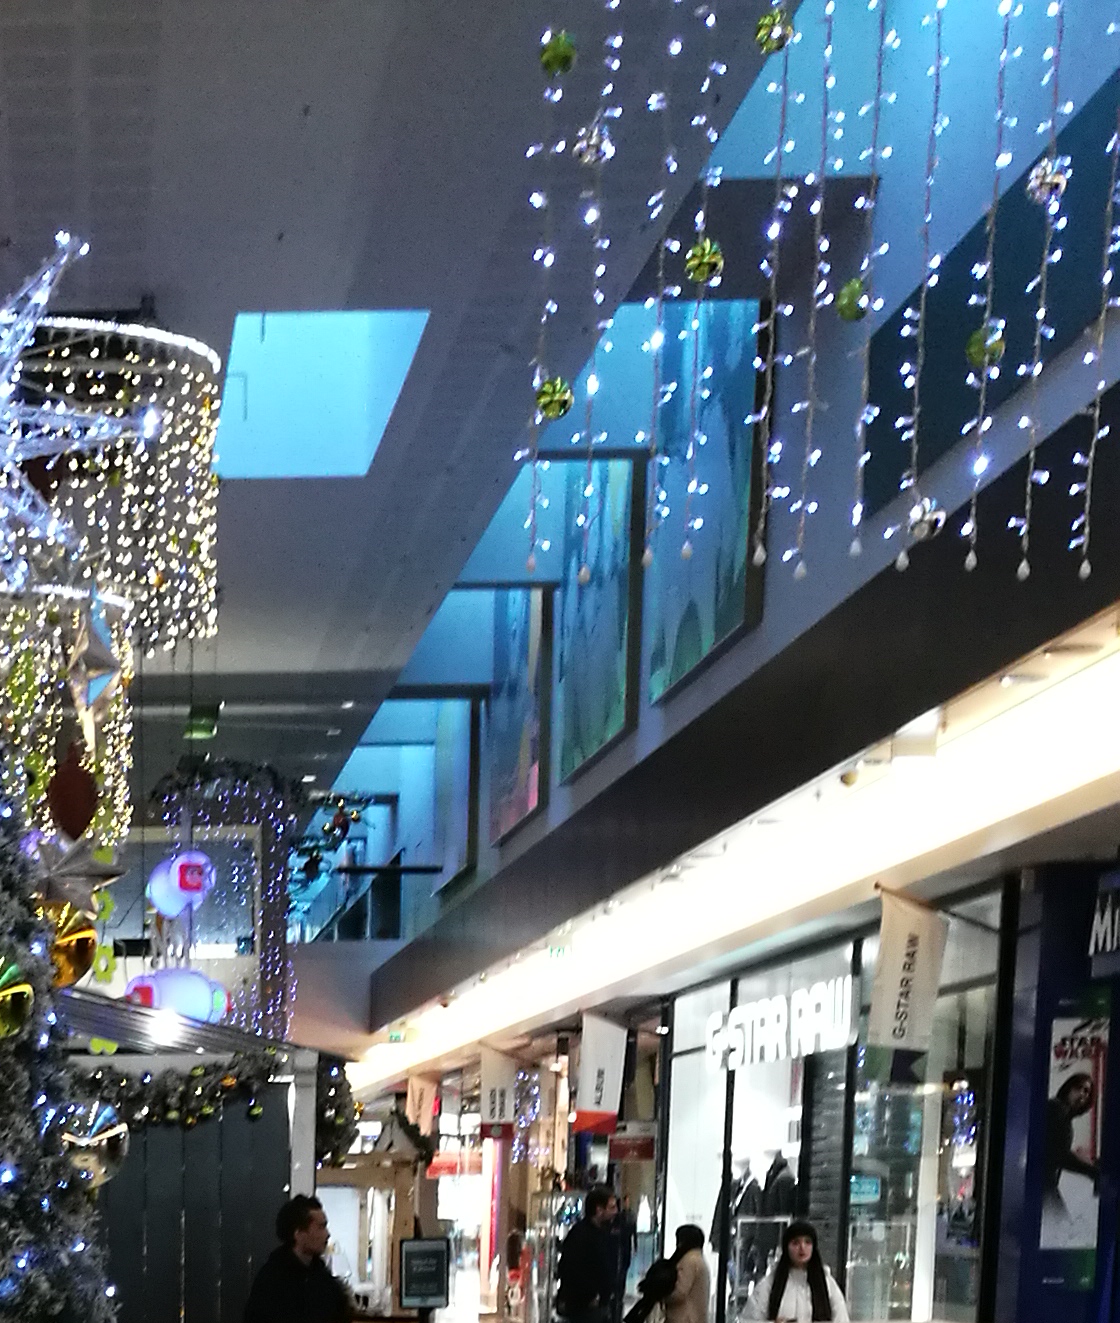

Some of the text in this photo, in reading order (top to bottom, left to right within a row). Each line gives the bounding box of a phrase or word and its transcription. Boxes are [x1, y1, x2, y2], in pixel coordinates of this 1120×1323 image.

[790, 974, 853, 1059] RAW
[892, 932, 920, 1040] G-STAR RAW
